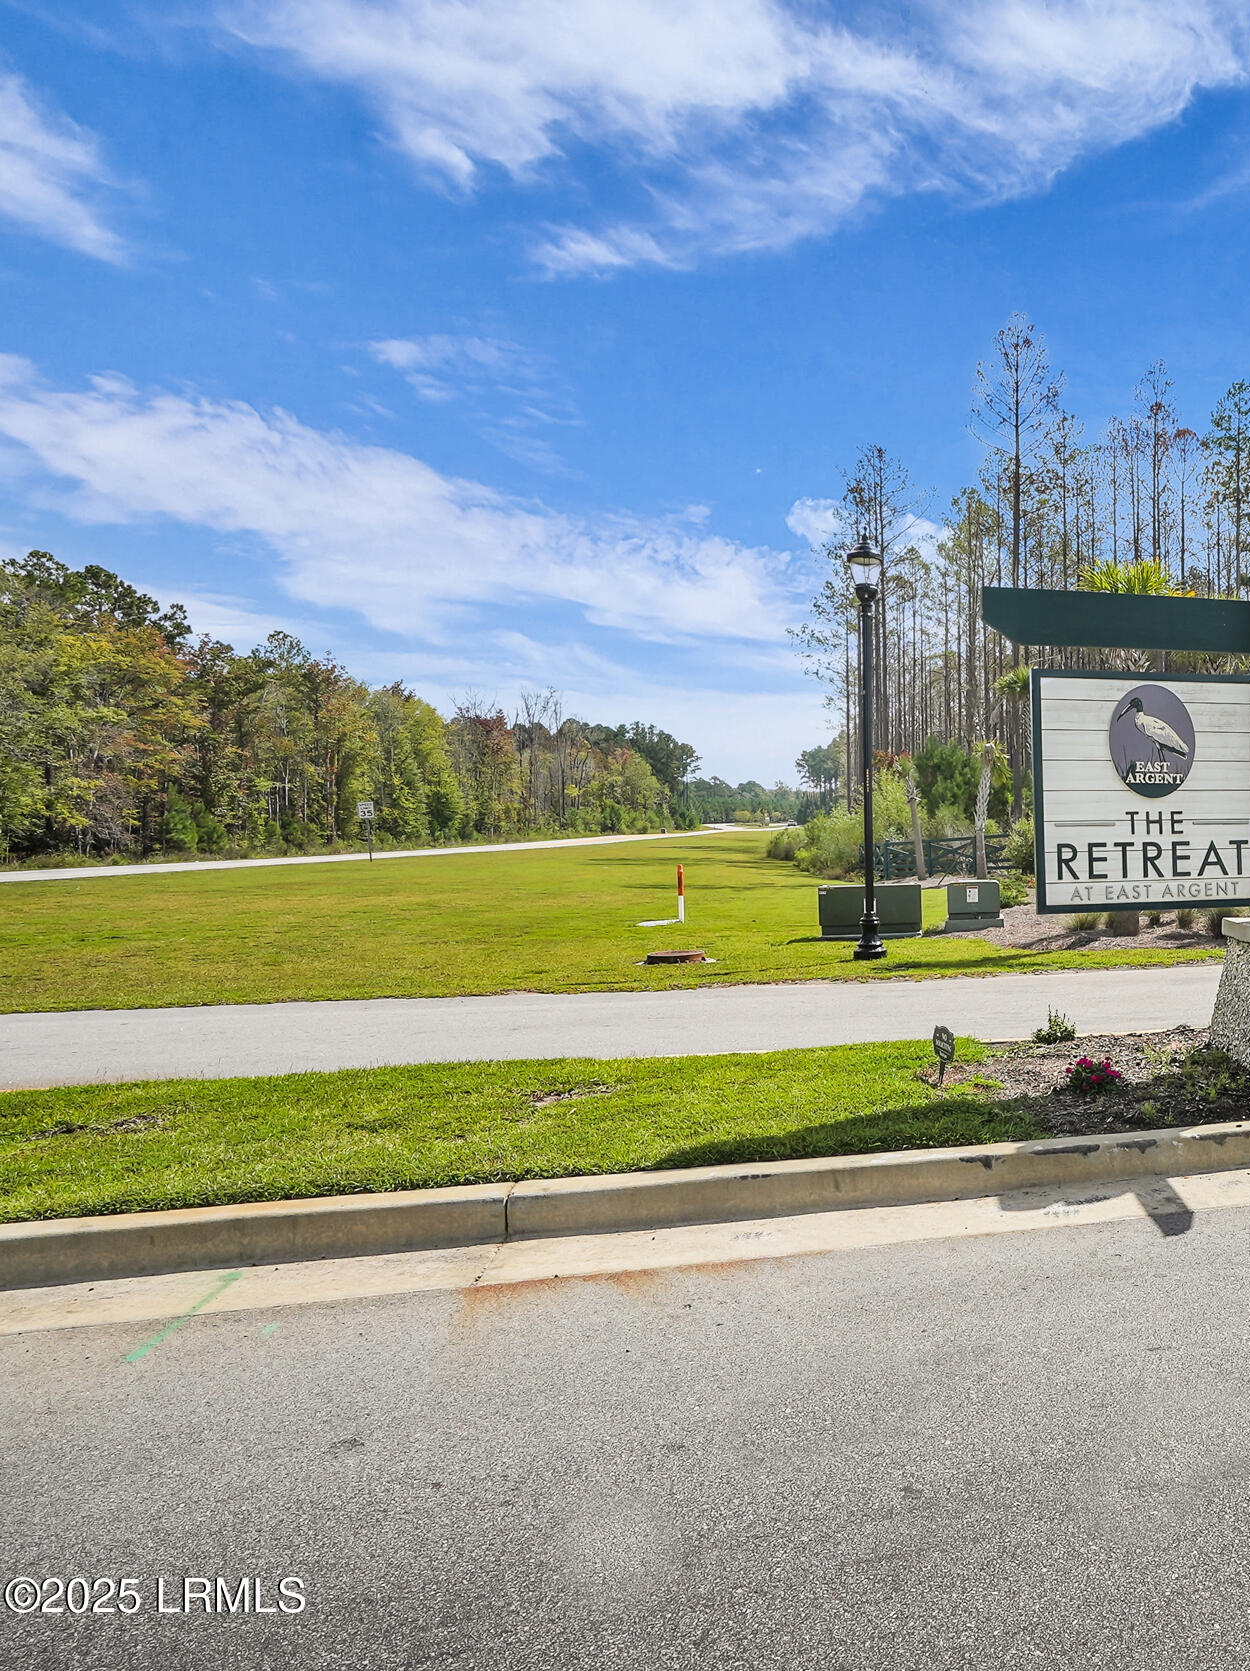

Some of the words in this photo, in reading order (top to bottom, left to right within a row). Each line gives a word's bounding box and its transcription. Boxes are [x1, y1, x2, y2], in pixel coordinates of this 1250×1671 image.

[1135, 761, 1170, 773] EAST
[1125, 773, 1184, 784] ARGENT
[1125, 810, 1184, 836] THE
[1056, 839, 1249, 881] RETREAT
[1070, 886, 1093, 902] AT
[1105, 884, 1152, 901] EAST
[1161, 881, 1239, 898] ARGENT
